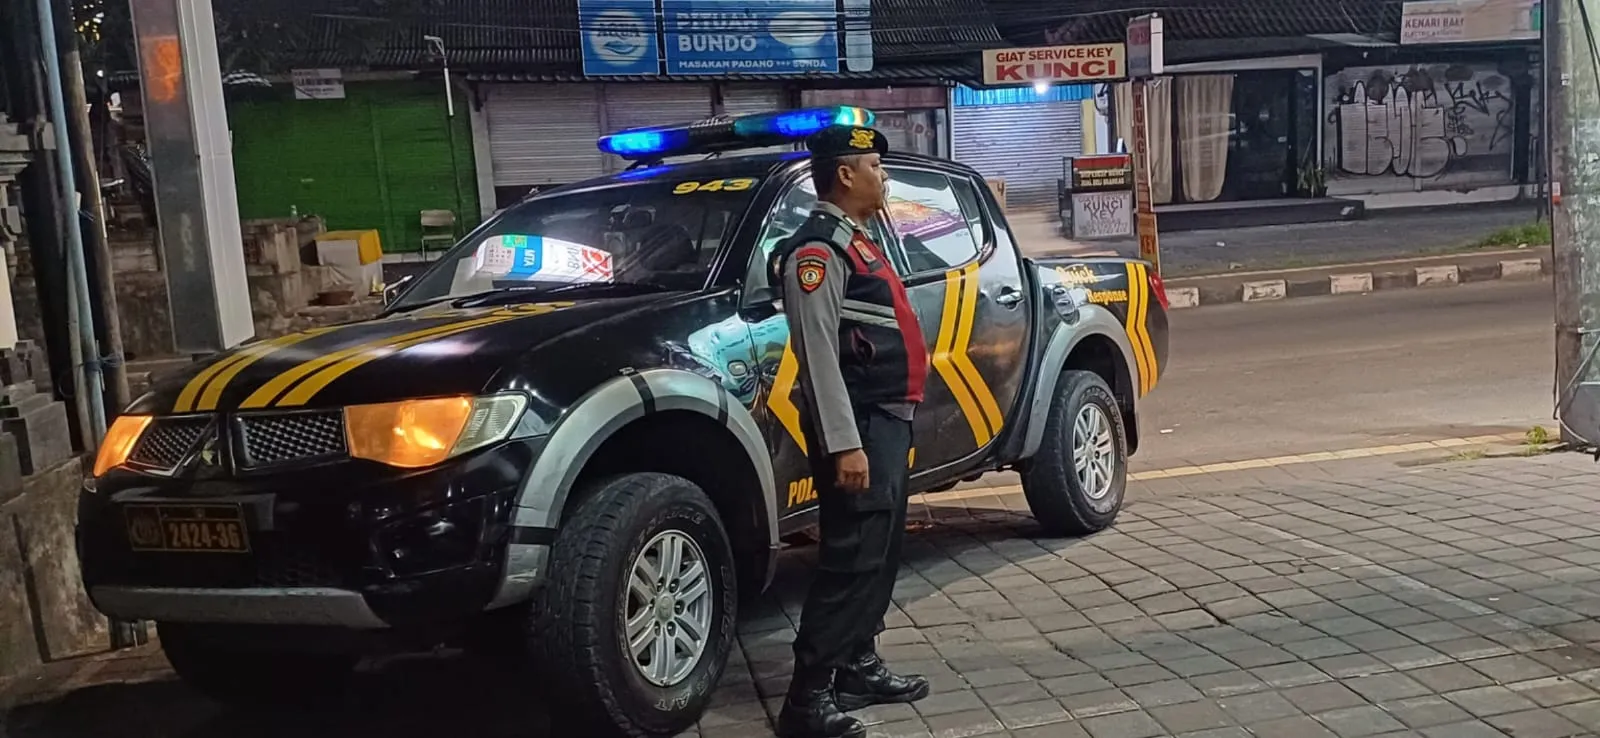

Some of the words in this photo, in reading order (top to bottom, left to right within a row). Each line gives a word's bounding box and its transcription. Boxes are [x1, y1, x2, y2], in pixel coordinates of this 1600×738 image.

[1404, 17, 1440, 29] KENARI
[678, 34, 757, 52] BUNDO
[996, 52, 1026, 63] GIAT
[1028, 49, 1085, 61] SERVICE
[1087, 47, 1114, 58] KEY
[679, 60, 729, 69] MASAKAN
[996, 59, 1116, 81] KUNCI
[1134, 94, 1146, 169] KUNCI
[672, 178, 752, 195] 943
[1083, 198, 1123, 211] KUNCI
[1090, 208, 1117, 220] KEY
[1086, 289, 1128, 305] Response
[168, 522, 241, 548] 2424-36
